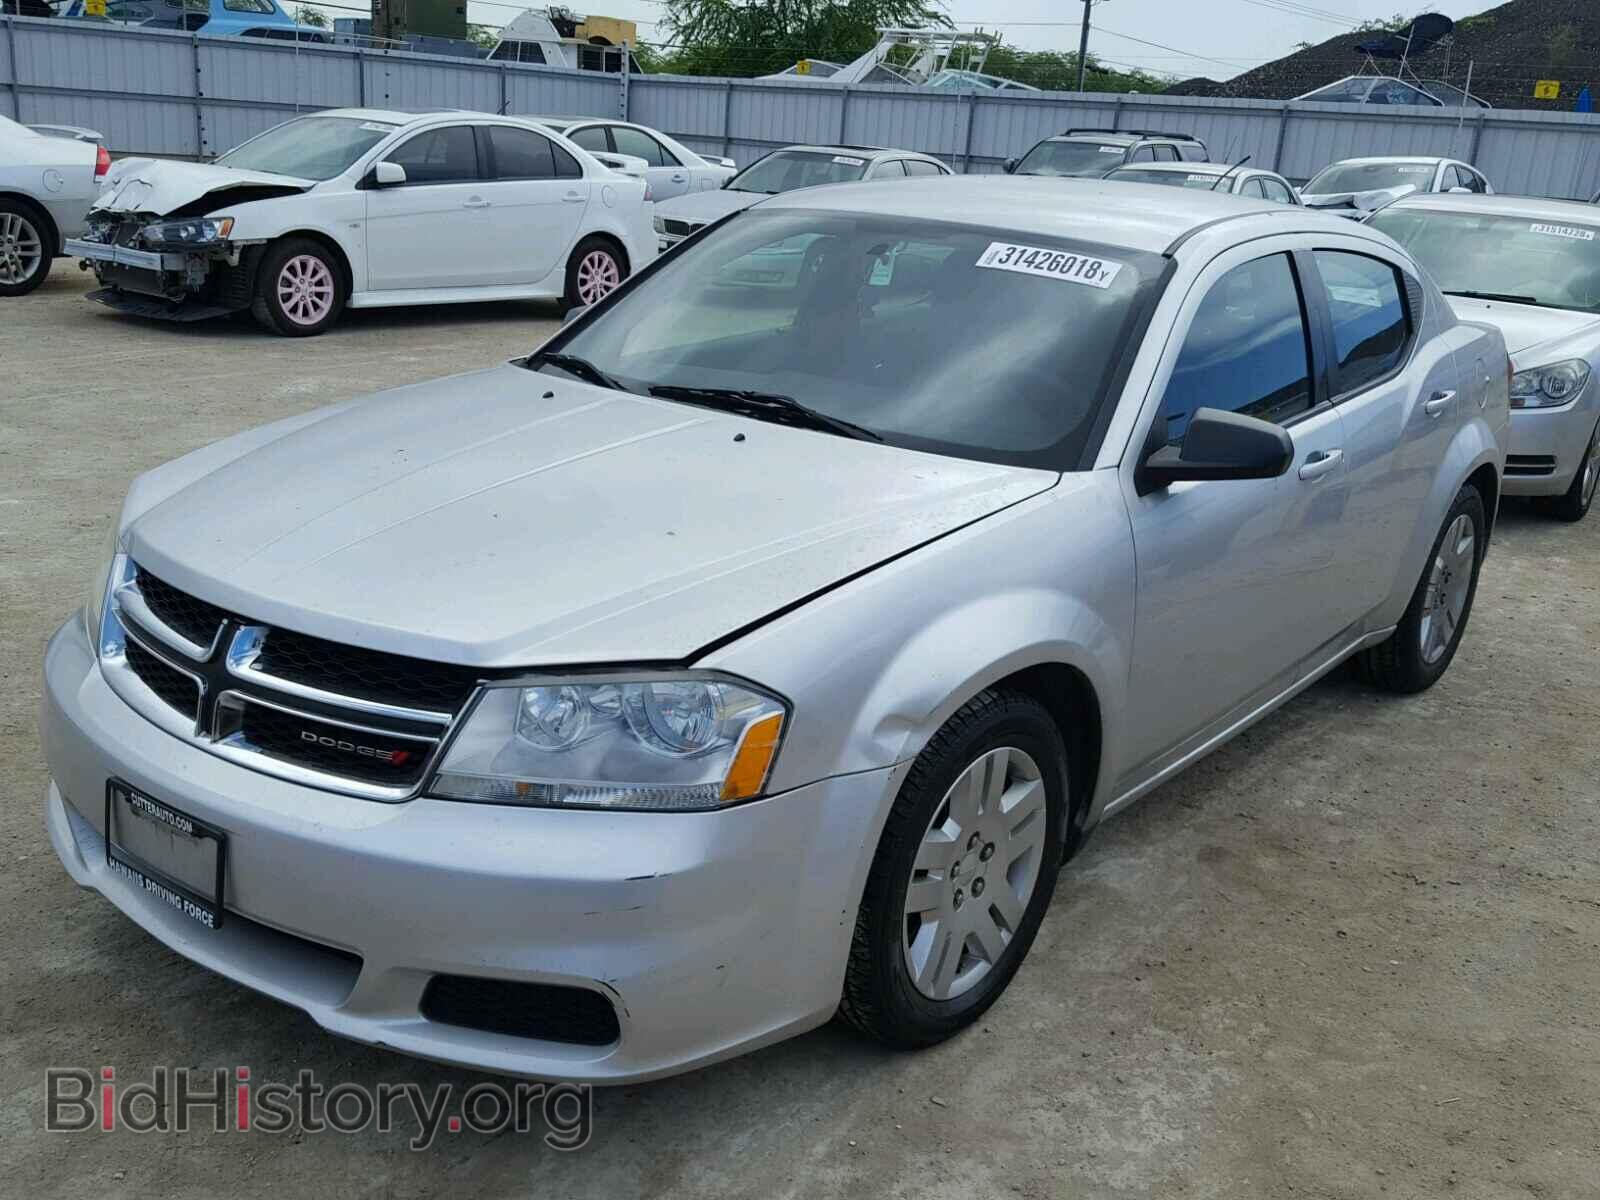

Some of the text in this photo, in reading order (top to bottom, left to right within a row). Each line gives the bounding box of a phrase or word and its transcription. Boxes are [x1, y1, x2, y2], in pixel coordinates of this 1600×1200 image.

[301, 731, 393, 760] DODGE
[131, 792, 193, 832] CUTTERAUTO.COM
[145, 878, 182, 909] DRIVING
[184, 900, 214, 928] FORCE
